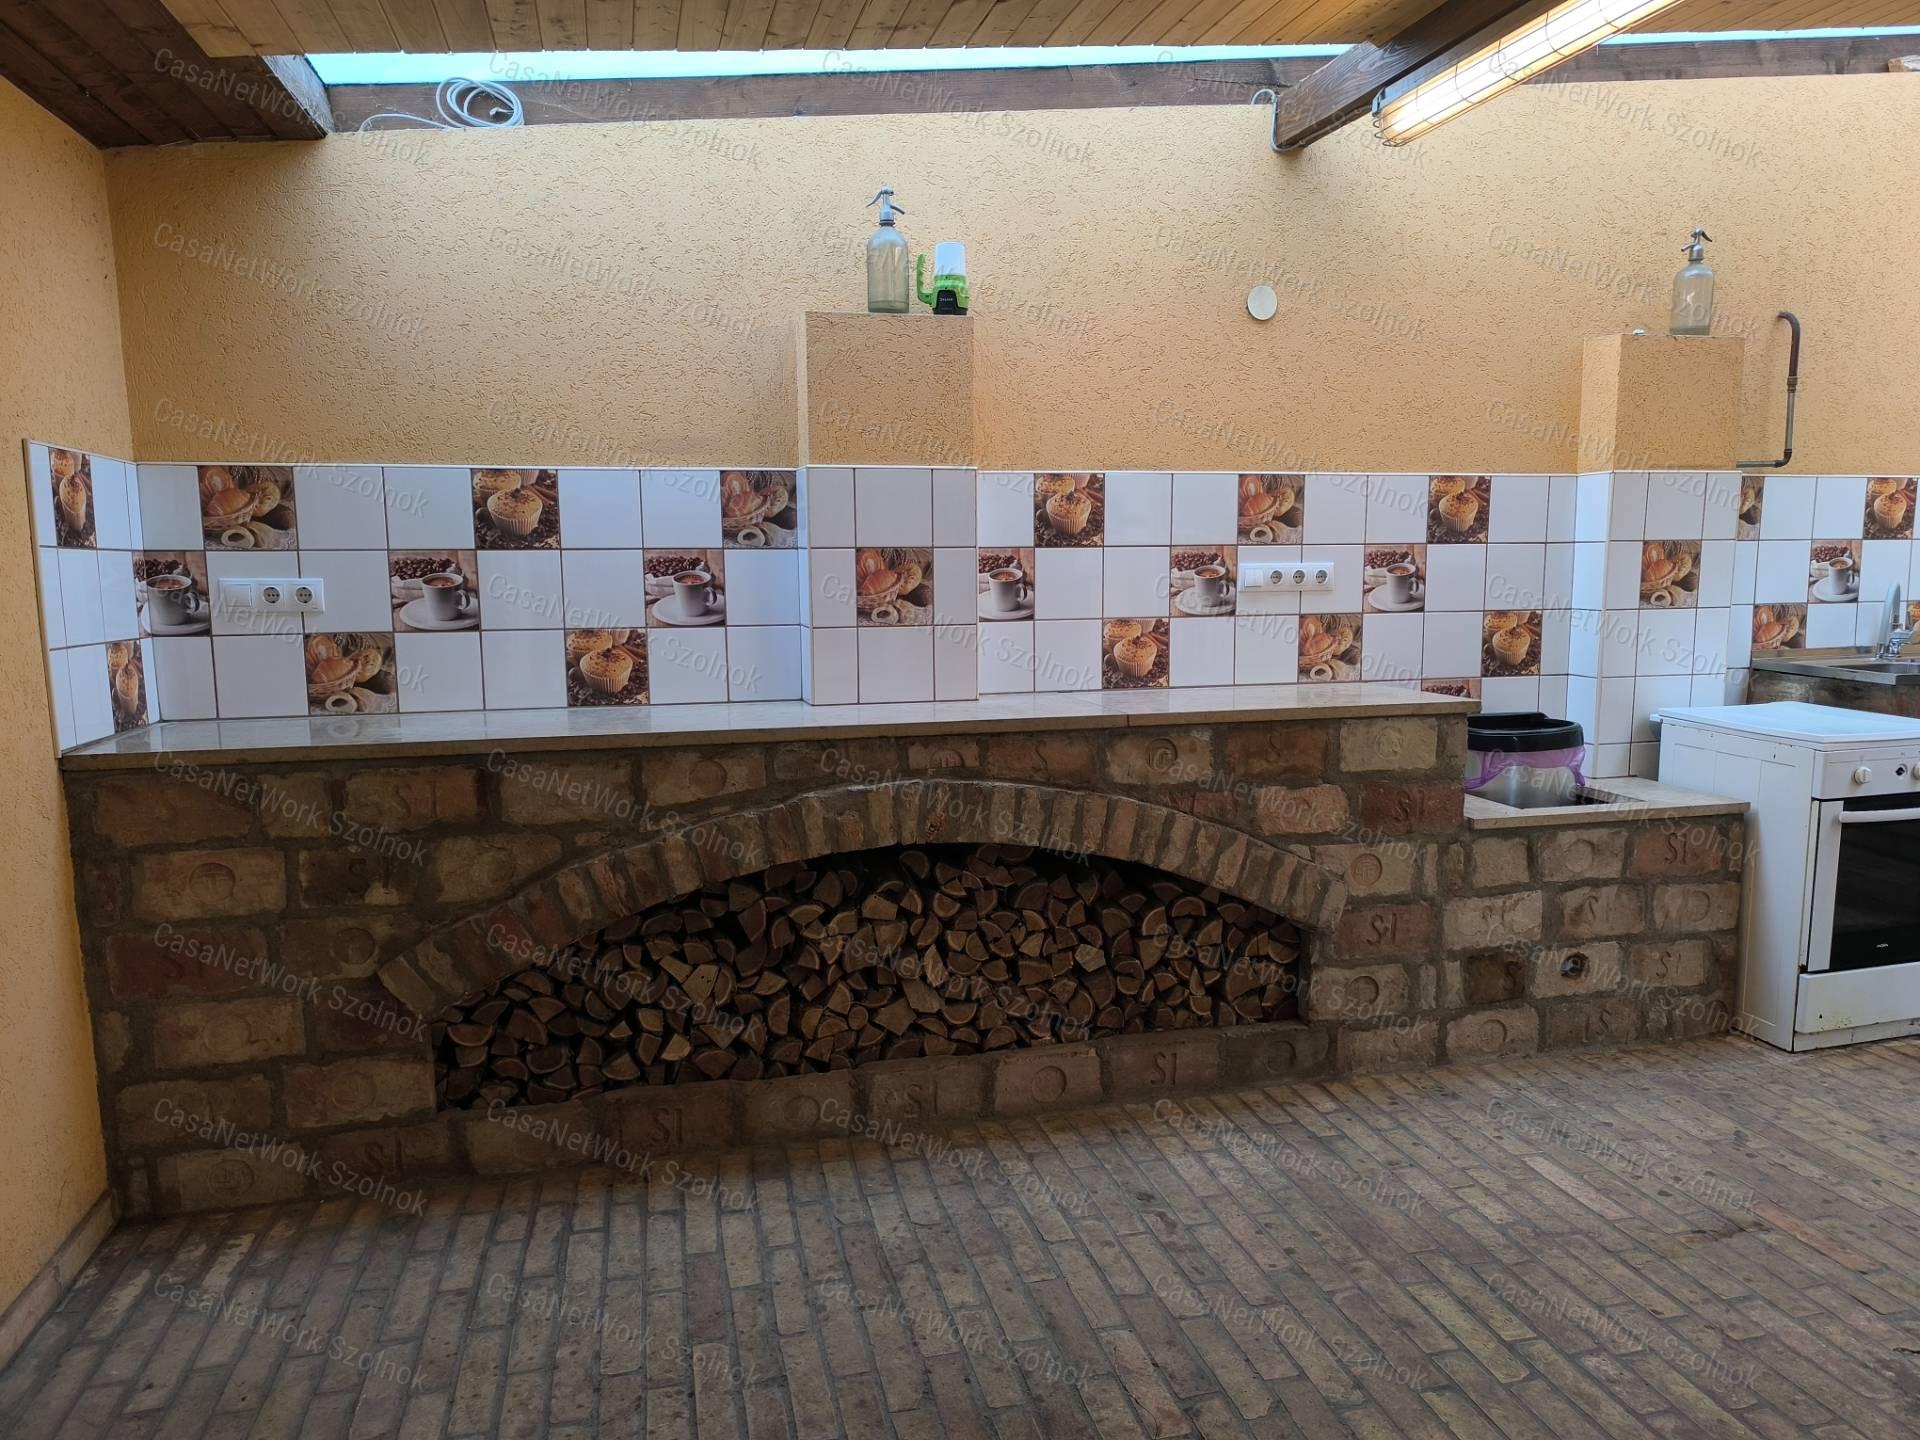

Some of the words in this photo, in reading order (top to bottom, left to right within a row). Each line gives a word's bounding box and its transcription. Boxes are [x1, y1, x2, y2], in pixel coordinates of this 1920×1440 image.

[1664, 833, 1688, 864] SI
[1655, 951, 1682, 978] SI
[1150, 1051, 1177, 1087] SI
